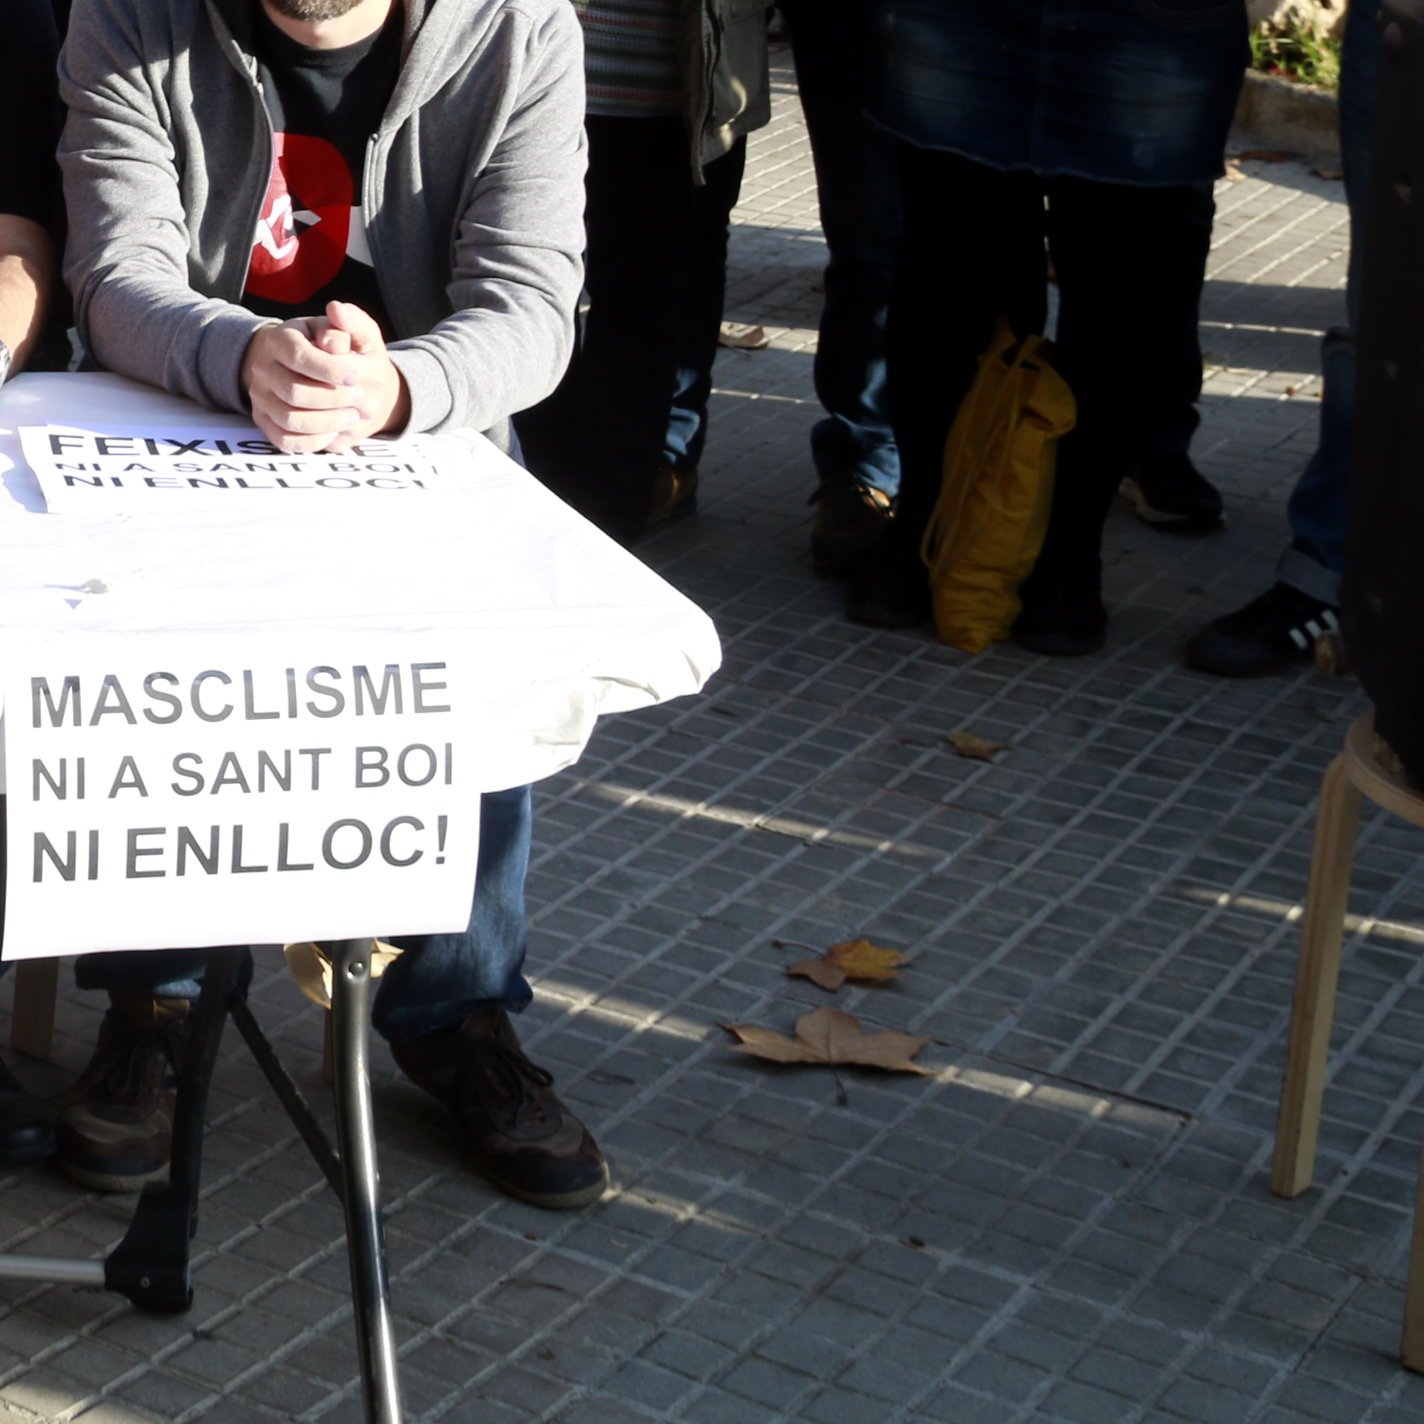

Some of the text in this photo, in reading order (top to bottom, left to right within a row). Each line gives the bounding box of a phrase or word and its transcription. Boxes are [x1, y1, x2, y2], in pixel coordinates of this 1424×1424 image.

[31, 662, 451, 728] MASCLISME
[32, 743, 452, 801] NI A SANT BOI
[33, 815, 448, 883] NI ENLLOC!
